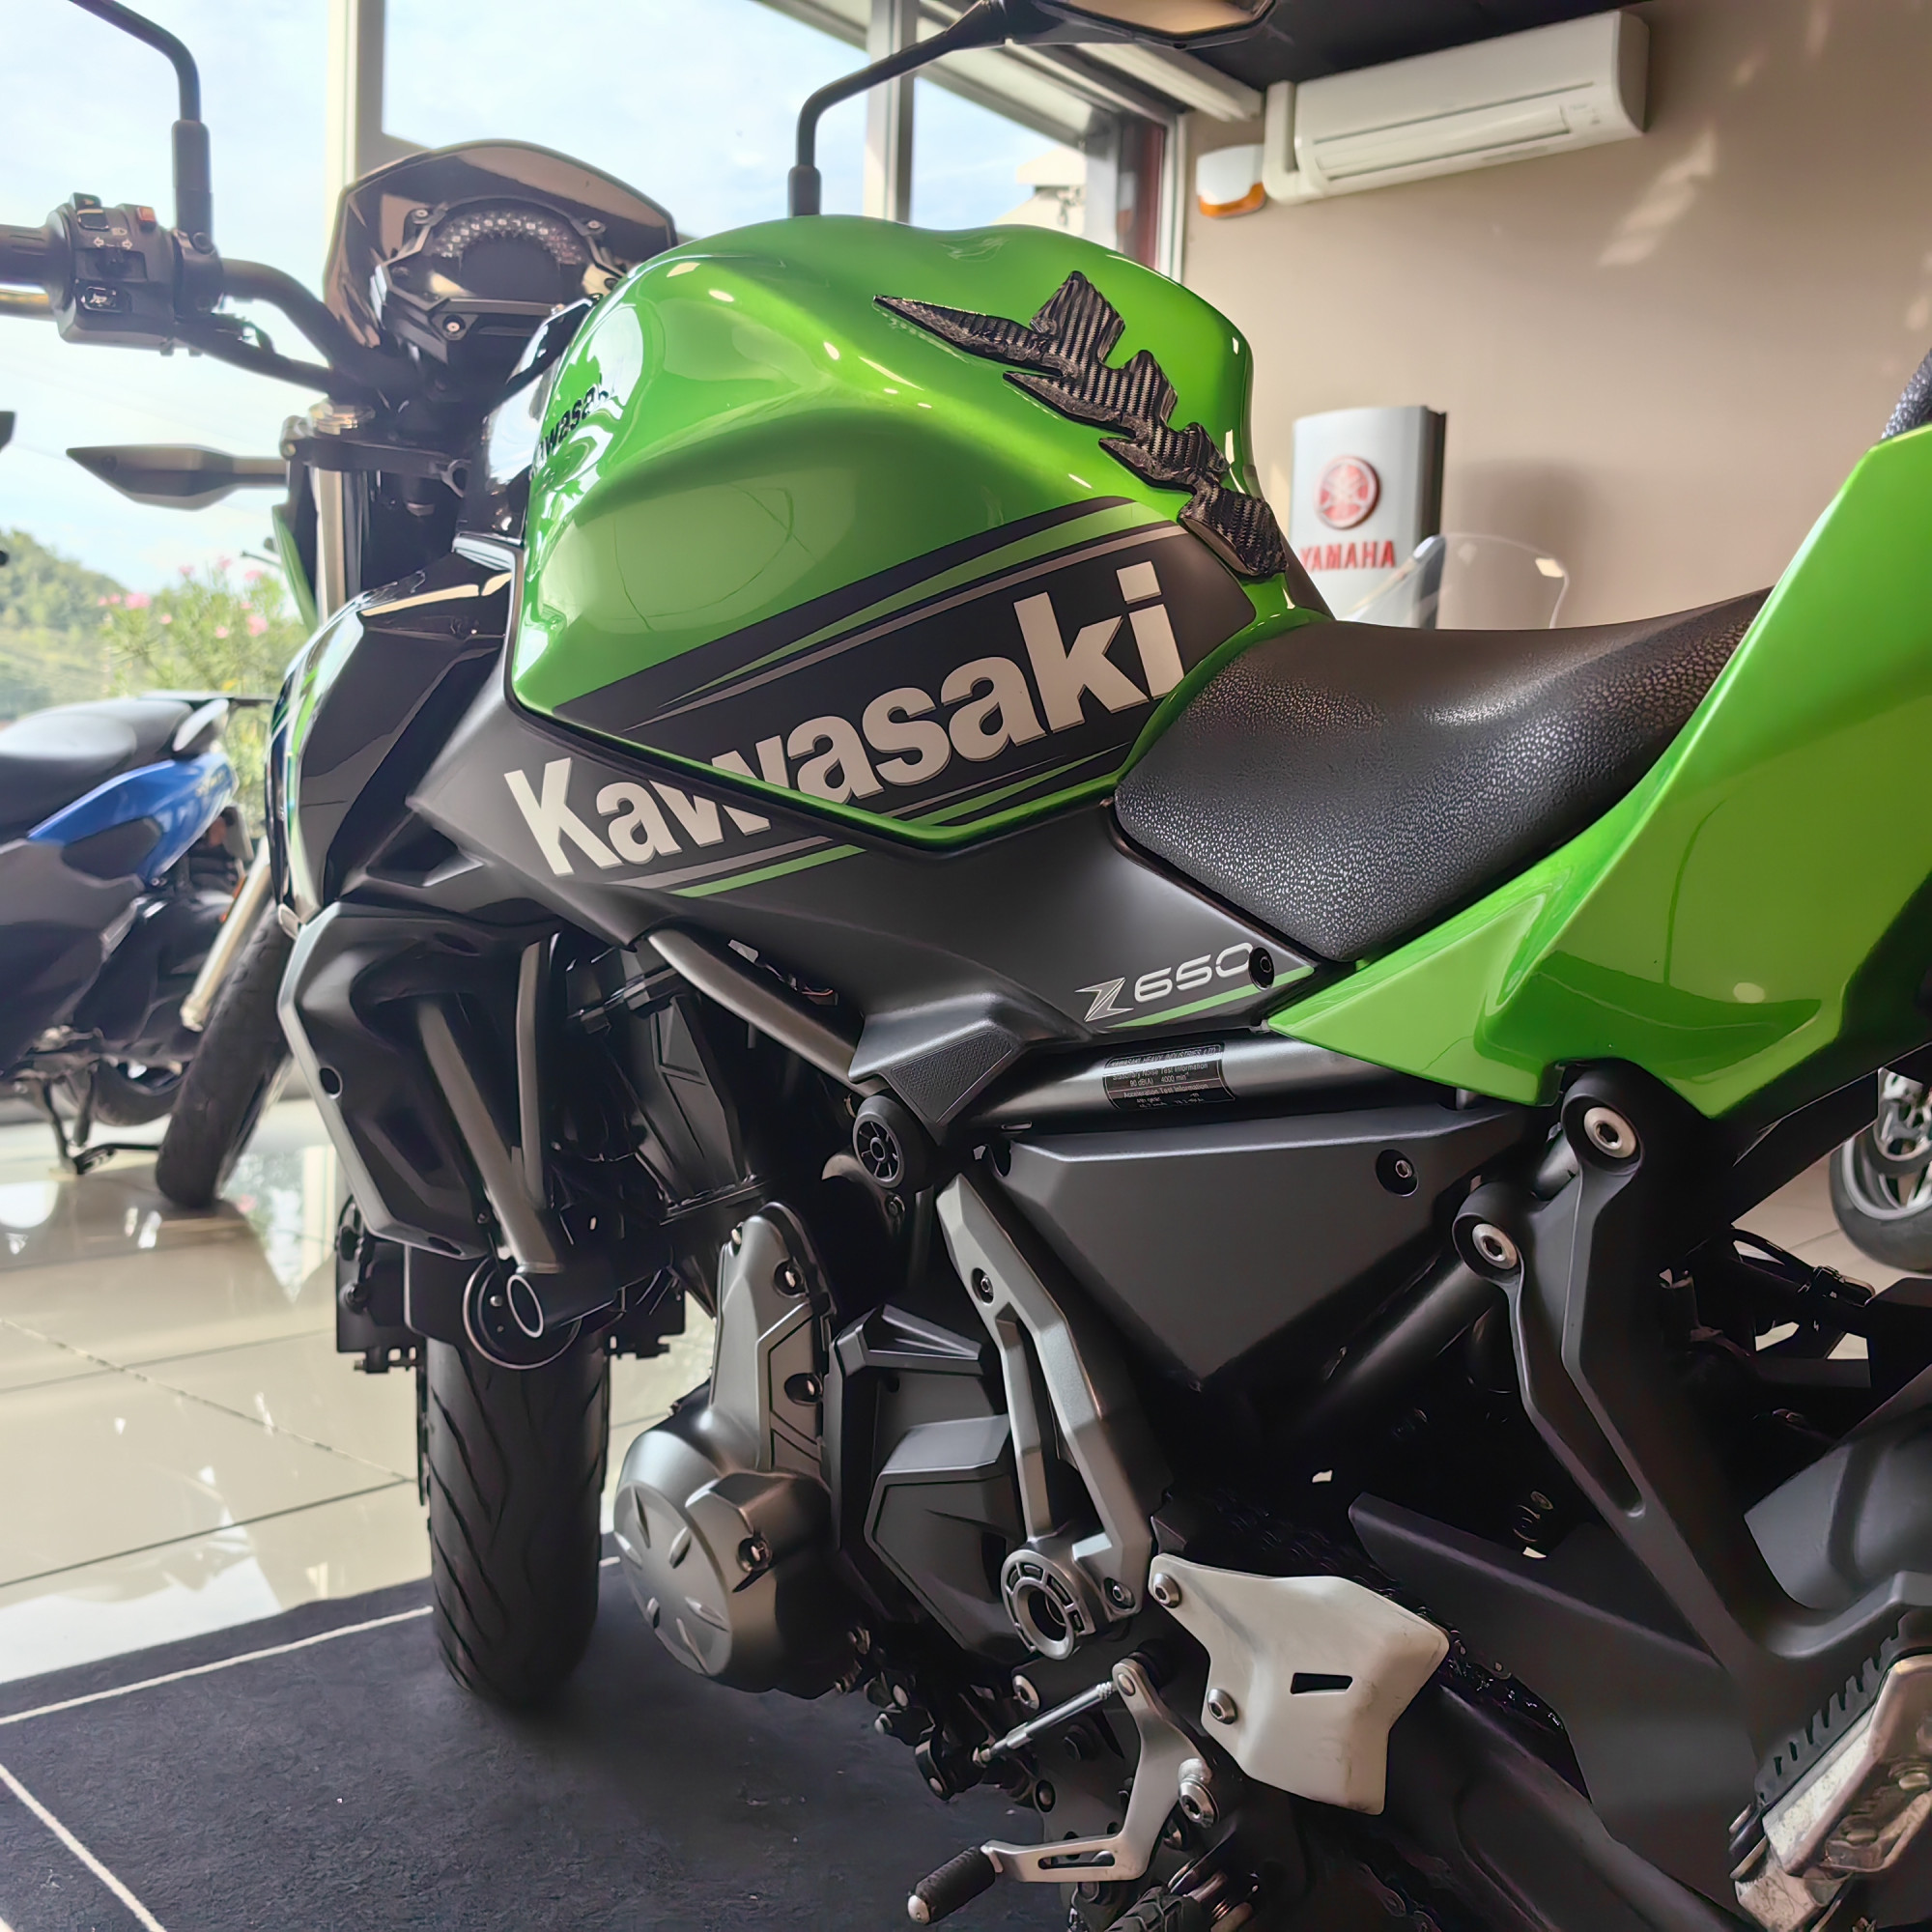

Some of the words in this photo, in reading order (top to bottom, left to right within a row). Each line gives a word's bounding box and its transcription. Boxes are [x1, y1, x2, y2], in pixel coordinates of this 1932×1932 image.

[1300, 539, 1395, 572] YAMAHA
[504, 560, 1185, 877] Kawasaki
[1074, 942, 1254, 1022] Z650
[1143, 1067, 1159, 1077] Noise
[1160, 1065, 1173, 1074] Test
[1174, 1063, 1208, 1072] Information
[1160, 1073, 1175, 1083] 4000
[1123, 1088, 1159, 1098] Acceleration
[1160, 1086, 1173, 1094] Test
[1174, 1083, 1209, 1093] Information
